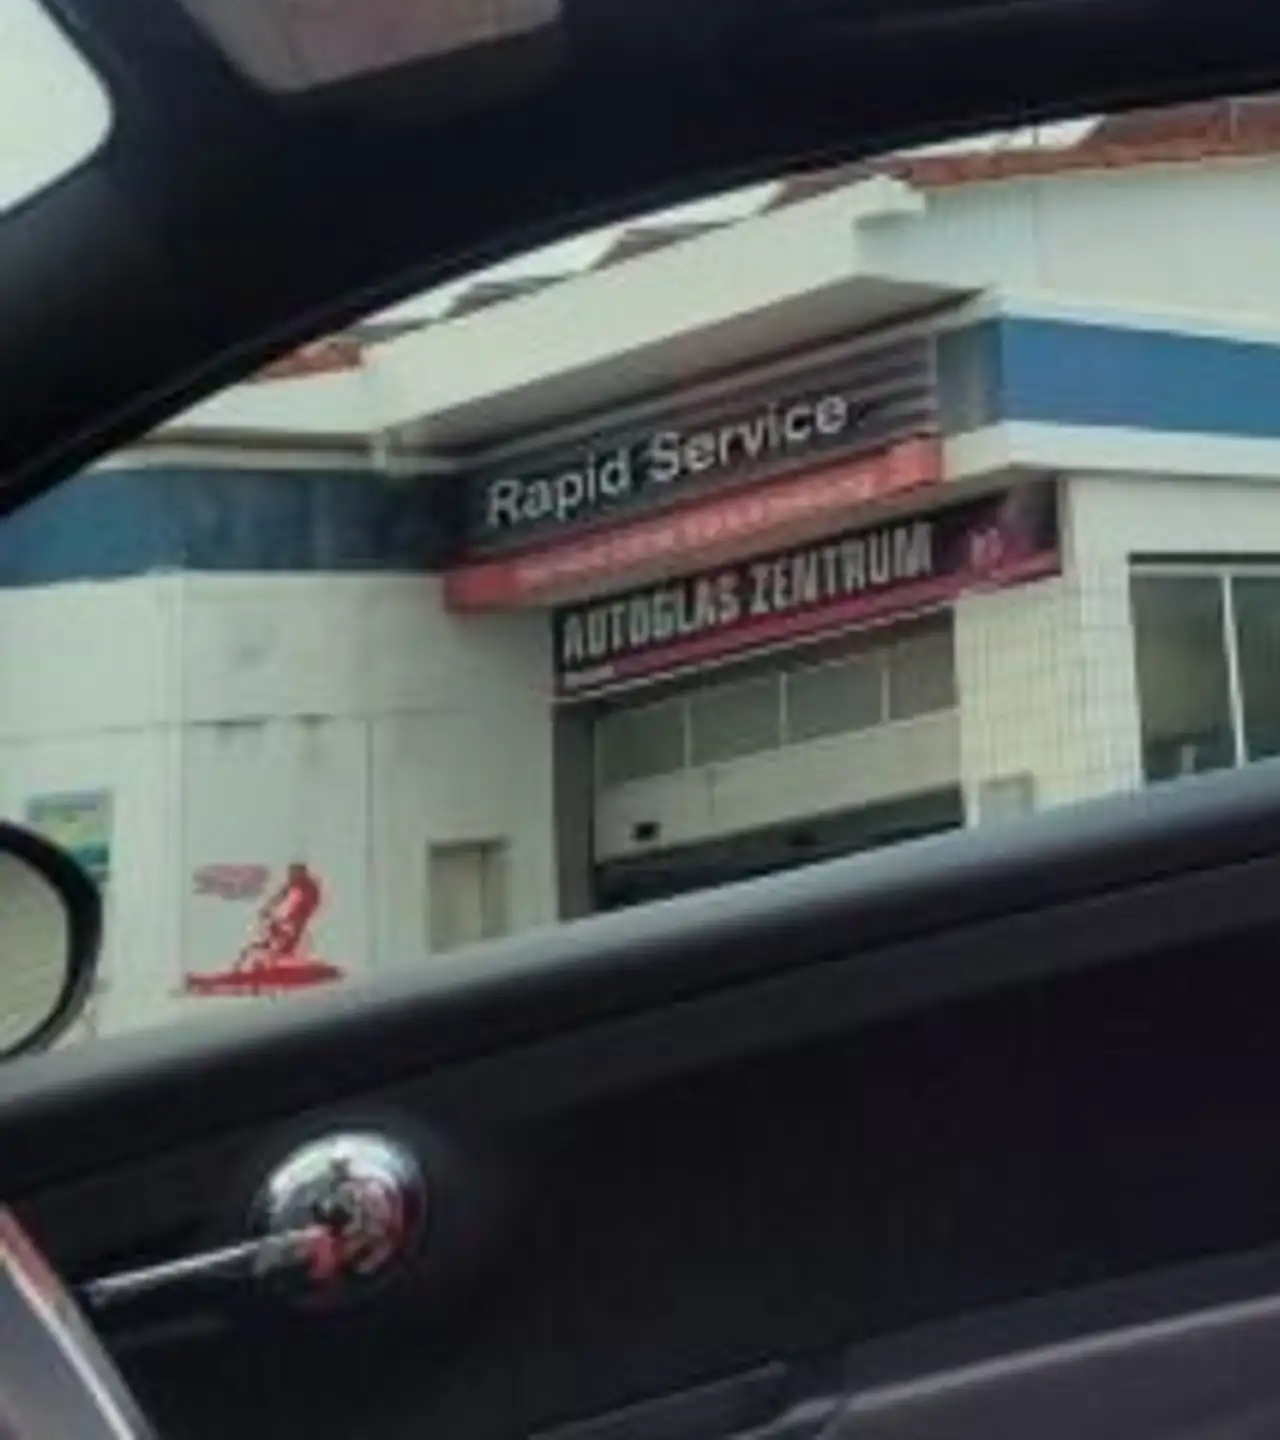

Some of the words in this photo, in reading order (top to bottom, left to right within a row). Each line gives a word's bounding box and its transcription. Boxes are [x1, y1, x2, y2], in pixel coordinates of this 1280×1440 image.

[487, 449, 631, 526] Rapid
[644, 395, 849, 482] Service
[564, 576, 744, 661] AUTOGLAS
[749, 521, 934, 615] ZENTRUM
